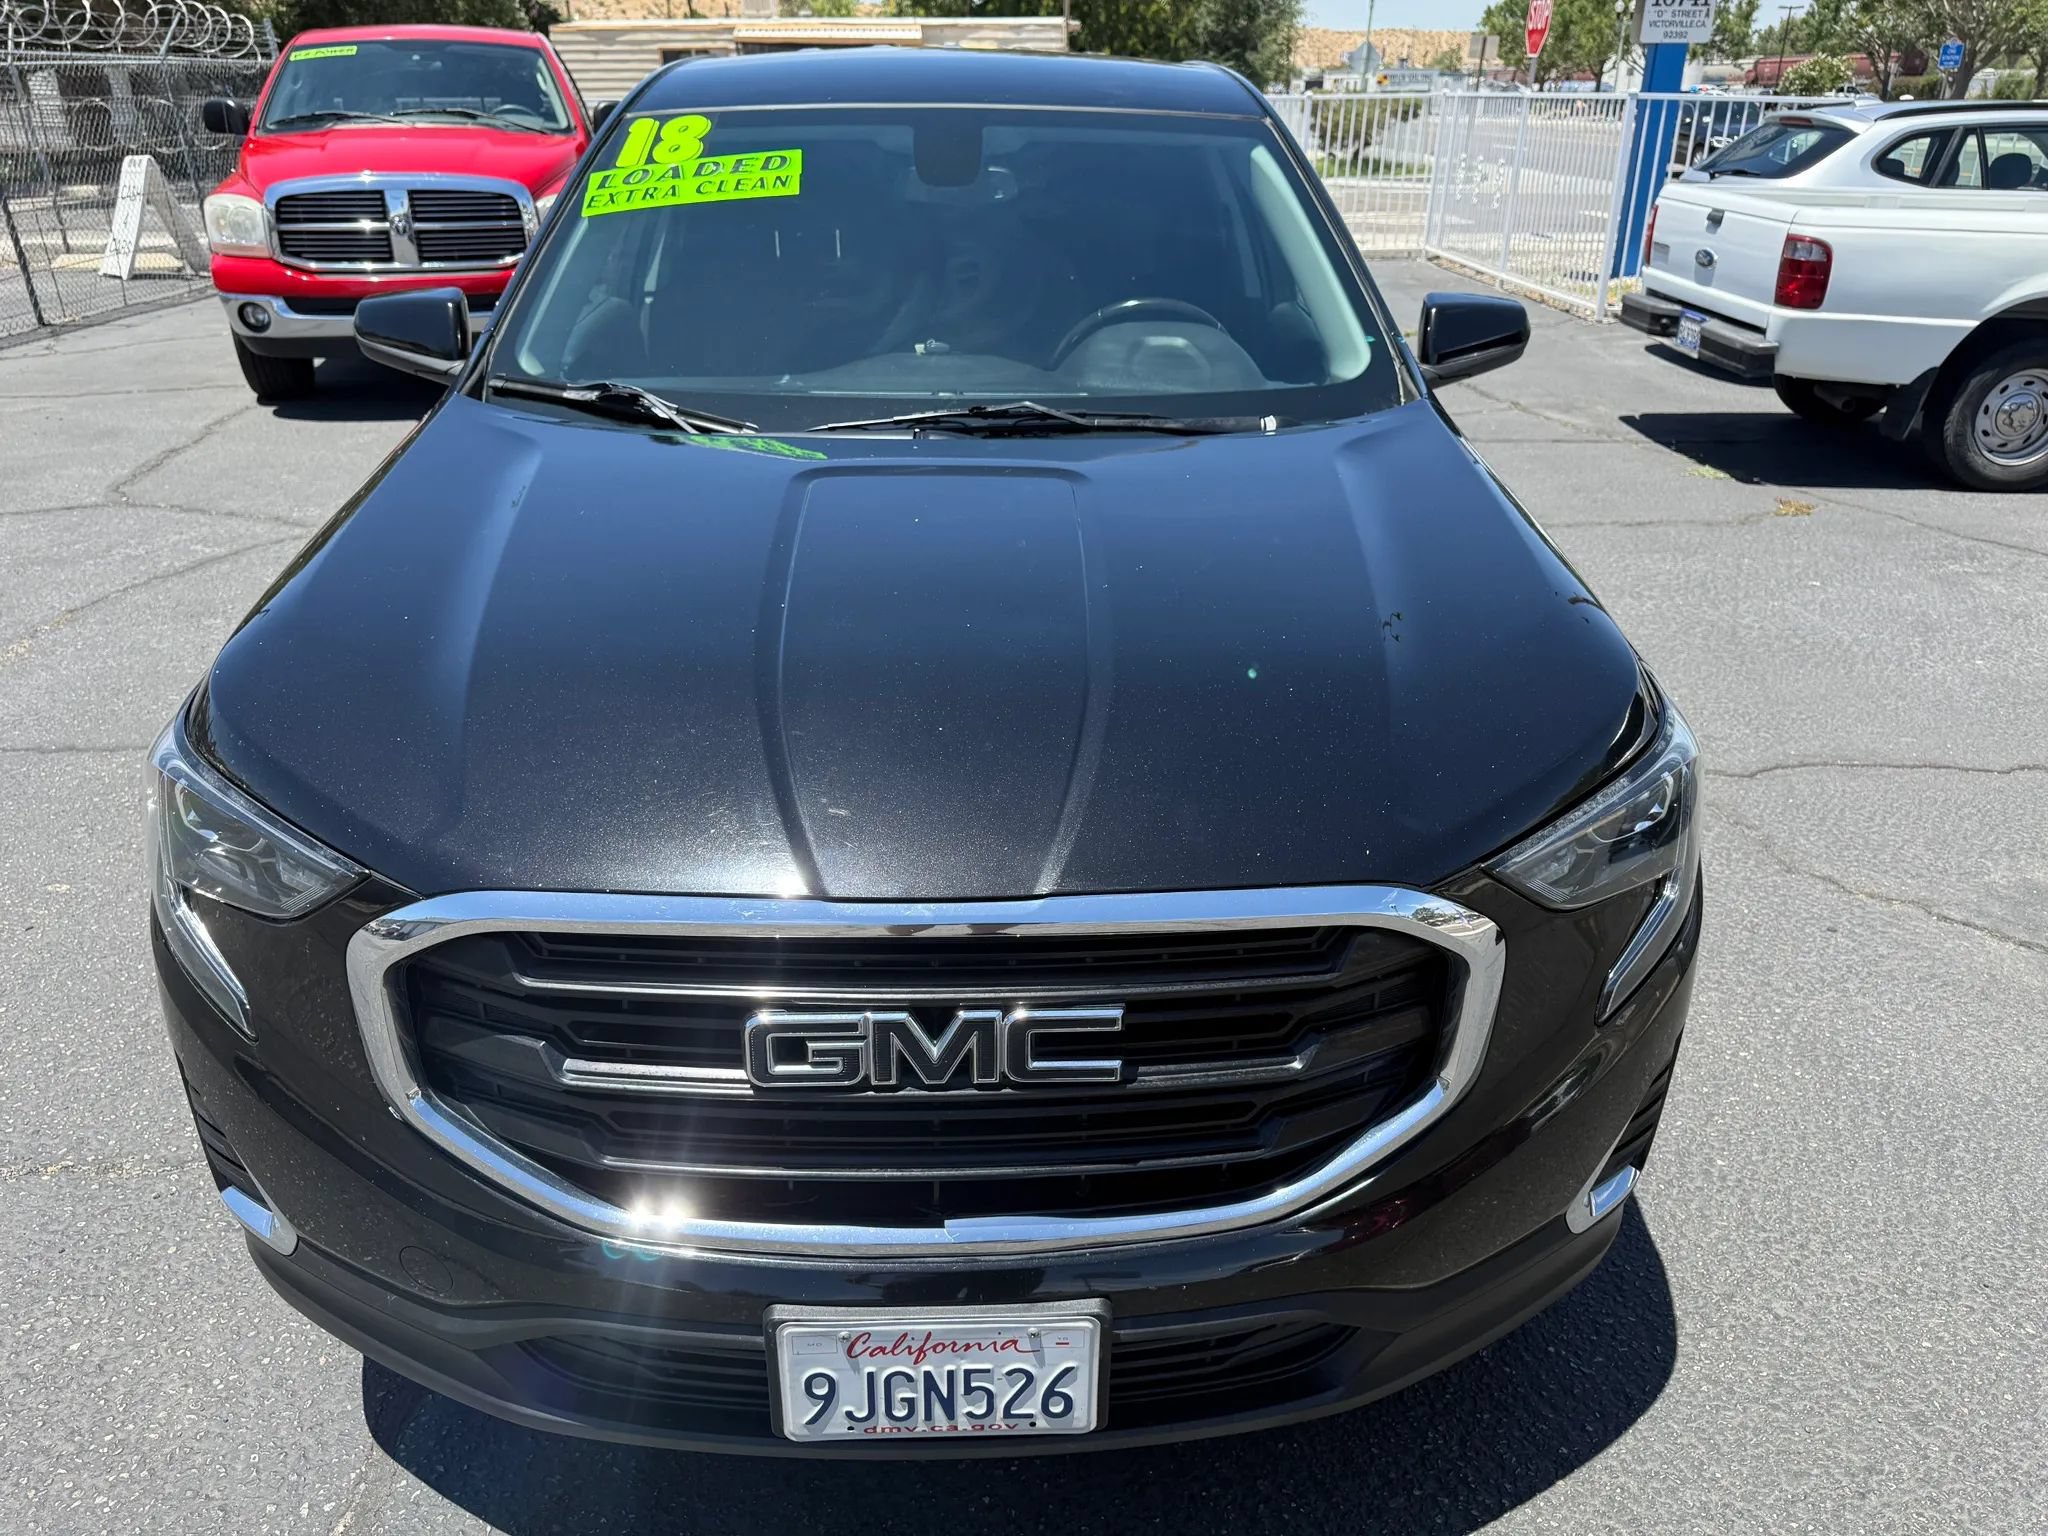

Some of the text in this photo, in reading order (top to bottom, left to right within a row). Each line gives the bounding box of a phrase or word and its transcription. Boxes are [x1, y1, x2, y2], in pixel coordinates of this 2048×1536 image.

[1529, 0, 1551, 30] STOP
[1671, 9, 1704, 19] STREET
[616, 114, 711, 168] 18
[595, 155, 792, 192] LOADED
[586, 174, 793, 210] EXTRA CLEAN
[745, 1005, 1124, 1087] GMC
[846, 1331, 1041, 1366] California
[803, 1365, 1078, 1426] 9JGN526
[863, 1422, 1019, 1435] dmv.ca.gov
